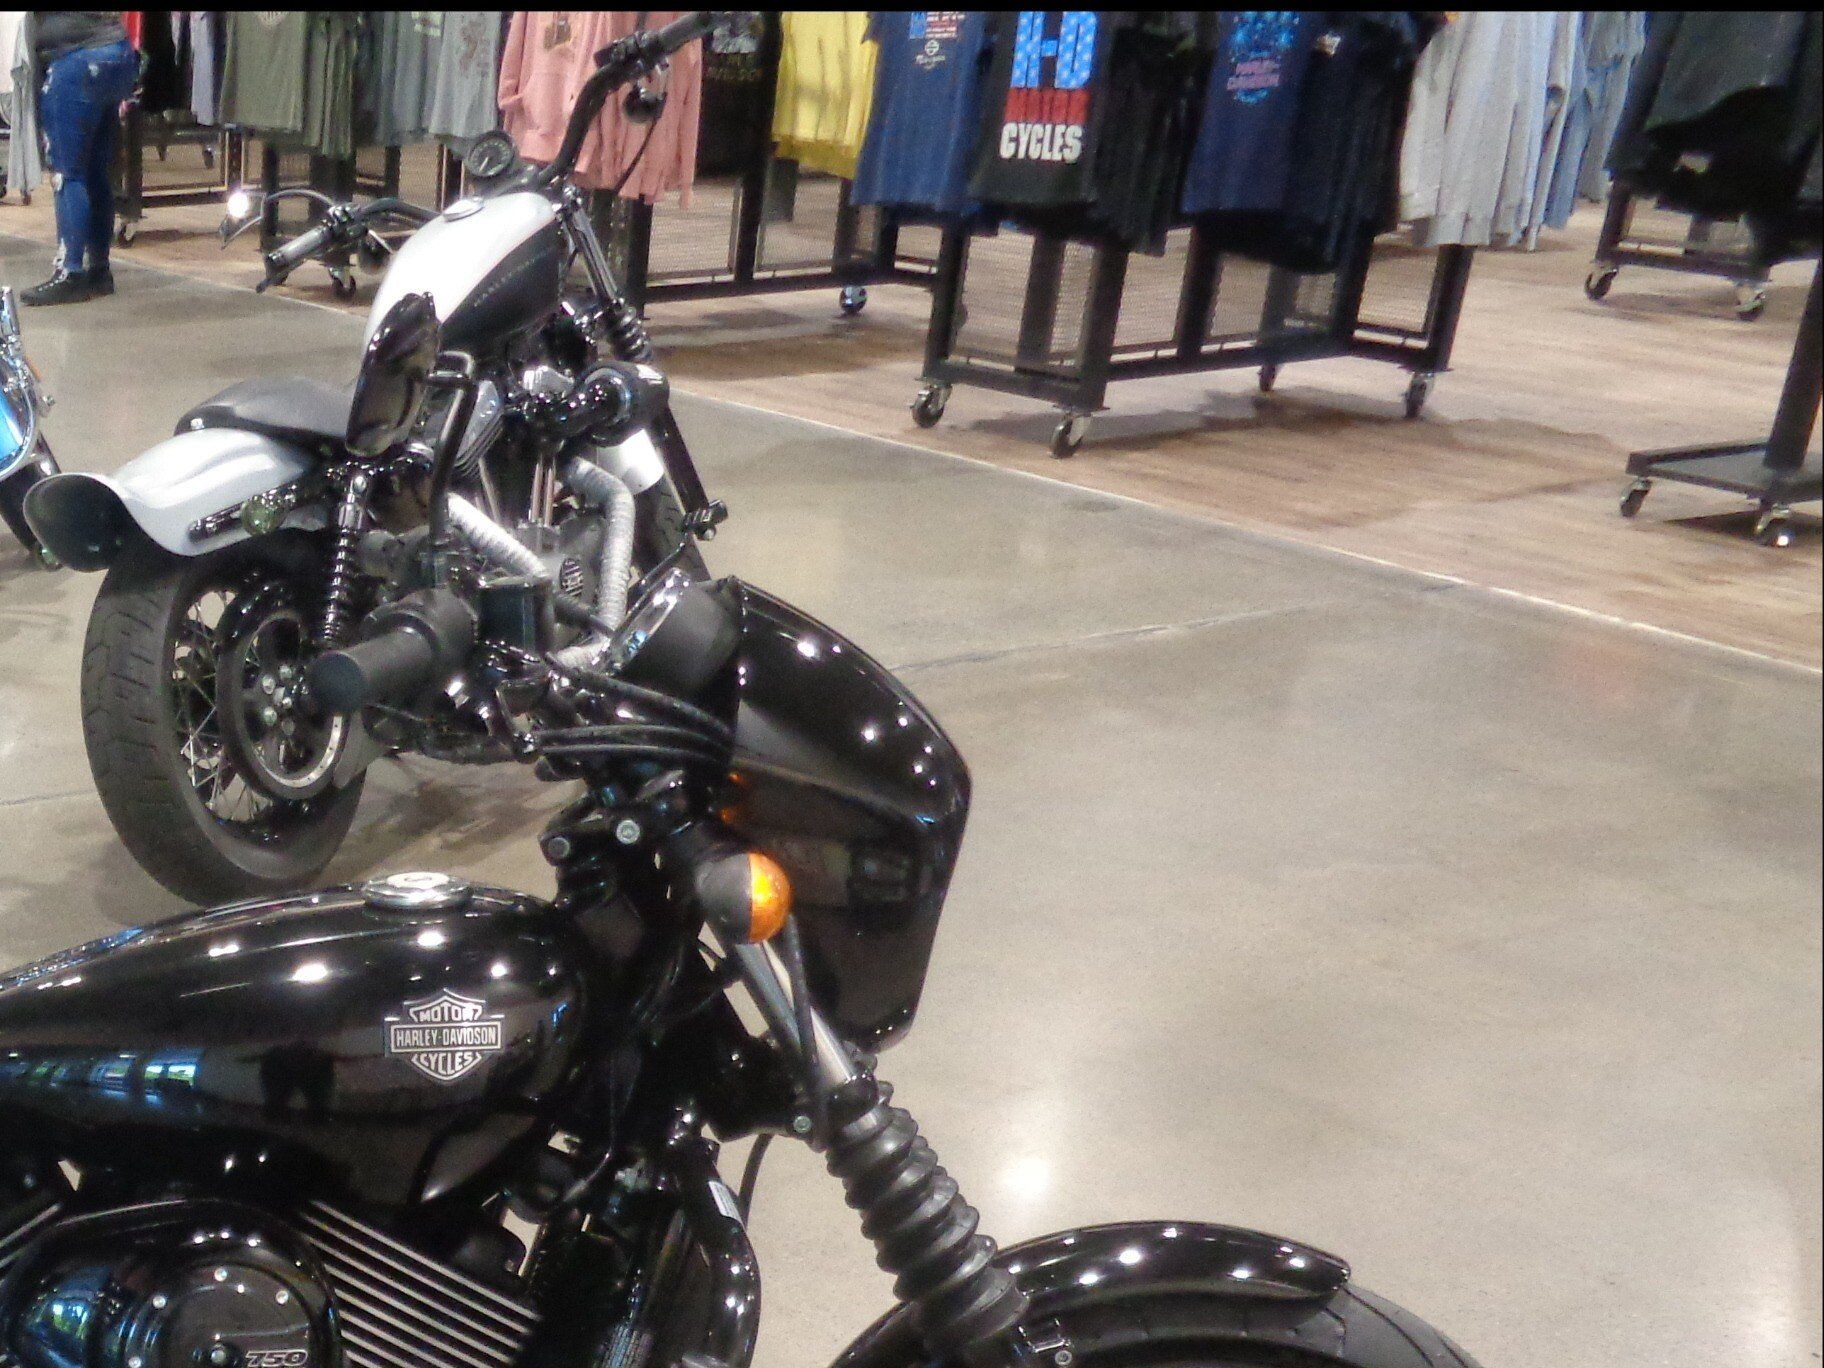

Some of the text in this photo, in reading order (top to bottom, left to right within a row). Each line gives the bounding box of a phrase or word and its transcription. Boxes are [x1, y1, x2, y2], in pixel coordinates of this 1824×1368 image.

[1010, 11, 1098, 89] H-D
[999, 122, 1082, 163] CYCLES
[419, 1001, 475, 1022] MOTOR
[396, 1027, 496, 1046] HARLEY-DAVIDSON
[419, 1051, 473, 1075] CYCLES
[245, 1349, 308, 1367] 750
